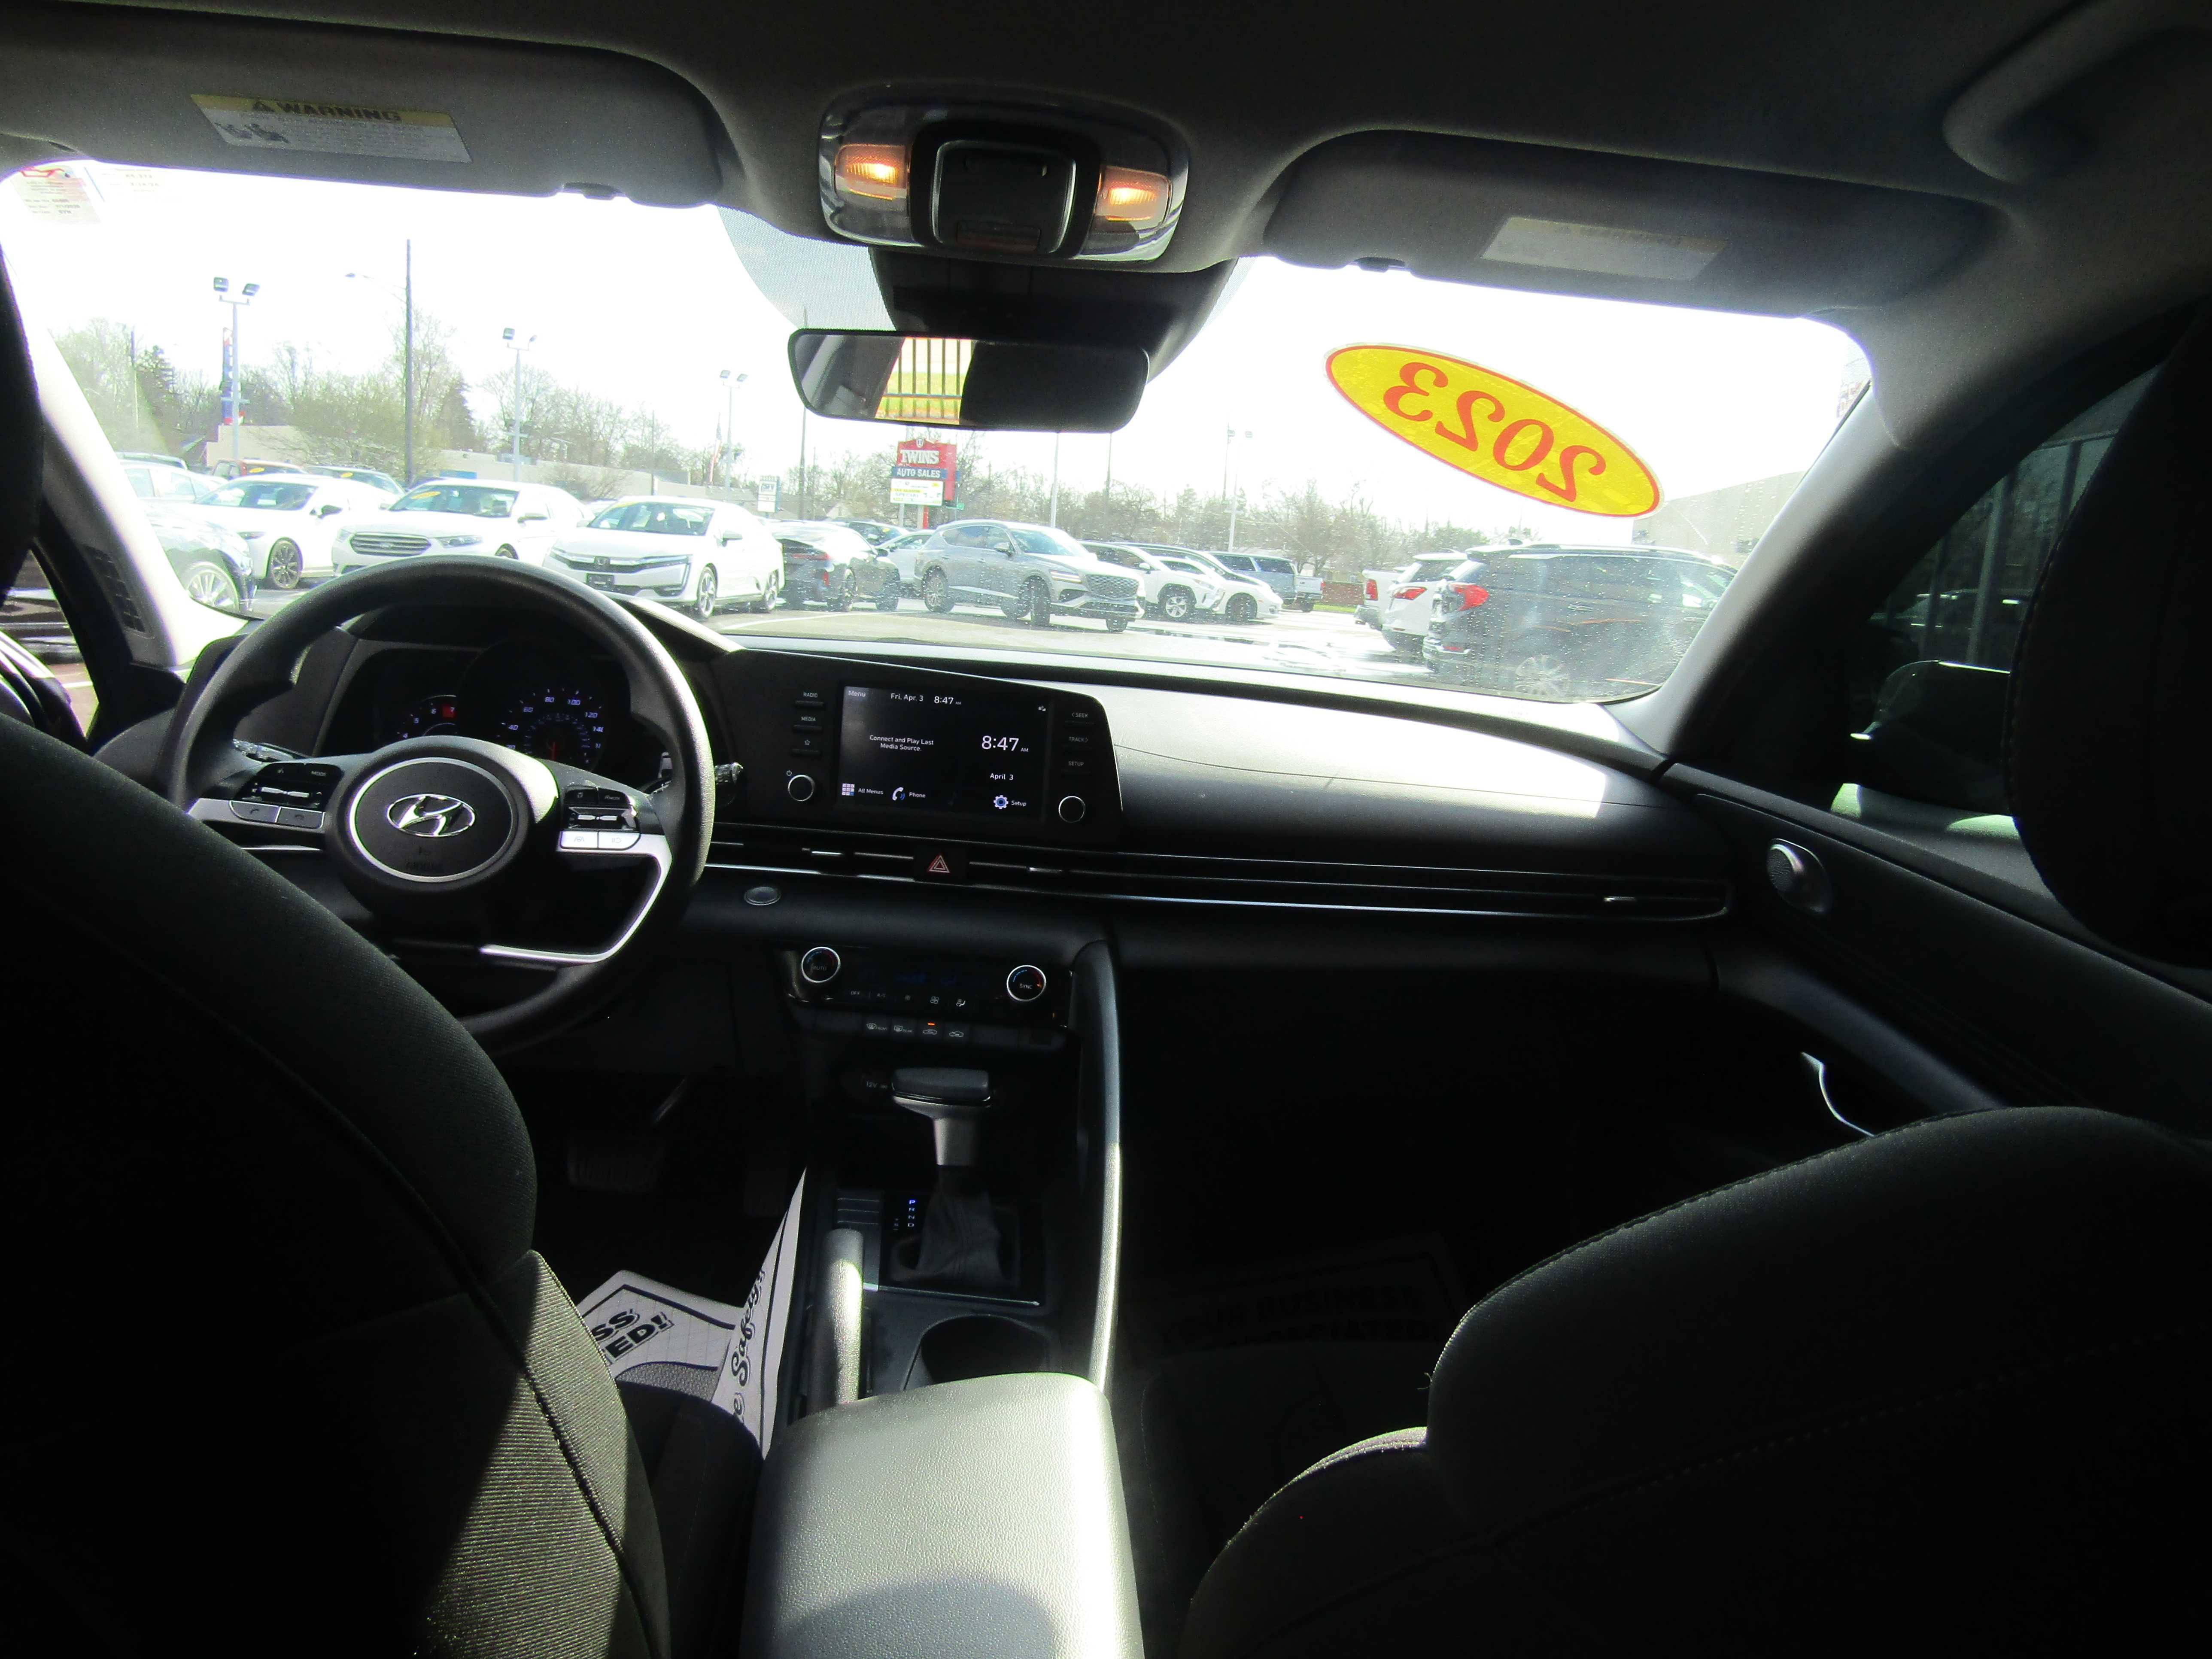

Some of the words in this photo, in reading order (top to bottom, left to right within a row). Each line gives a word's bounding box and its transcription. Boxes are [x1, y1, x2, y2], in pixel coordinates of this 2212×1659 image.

[276, 102, 402, 122] WARNING
[900, 450, 939, 465] TWINS
[897, 468, 915, 477] AUTO
[917, 469, 940, 478] SALES
[934, 696, 954, 705] 8:47
[981, 735, 1019, 751] 8:47
